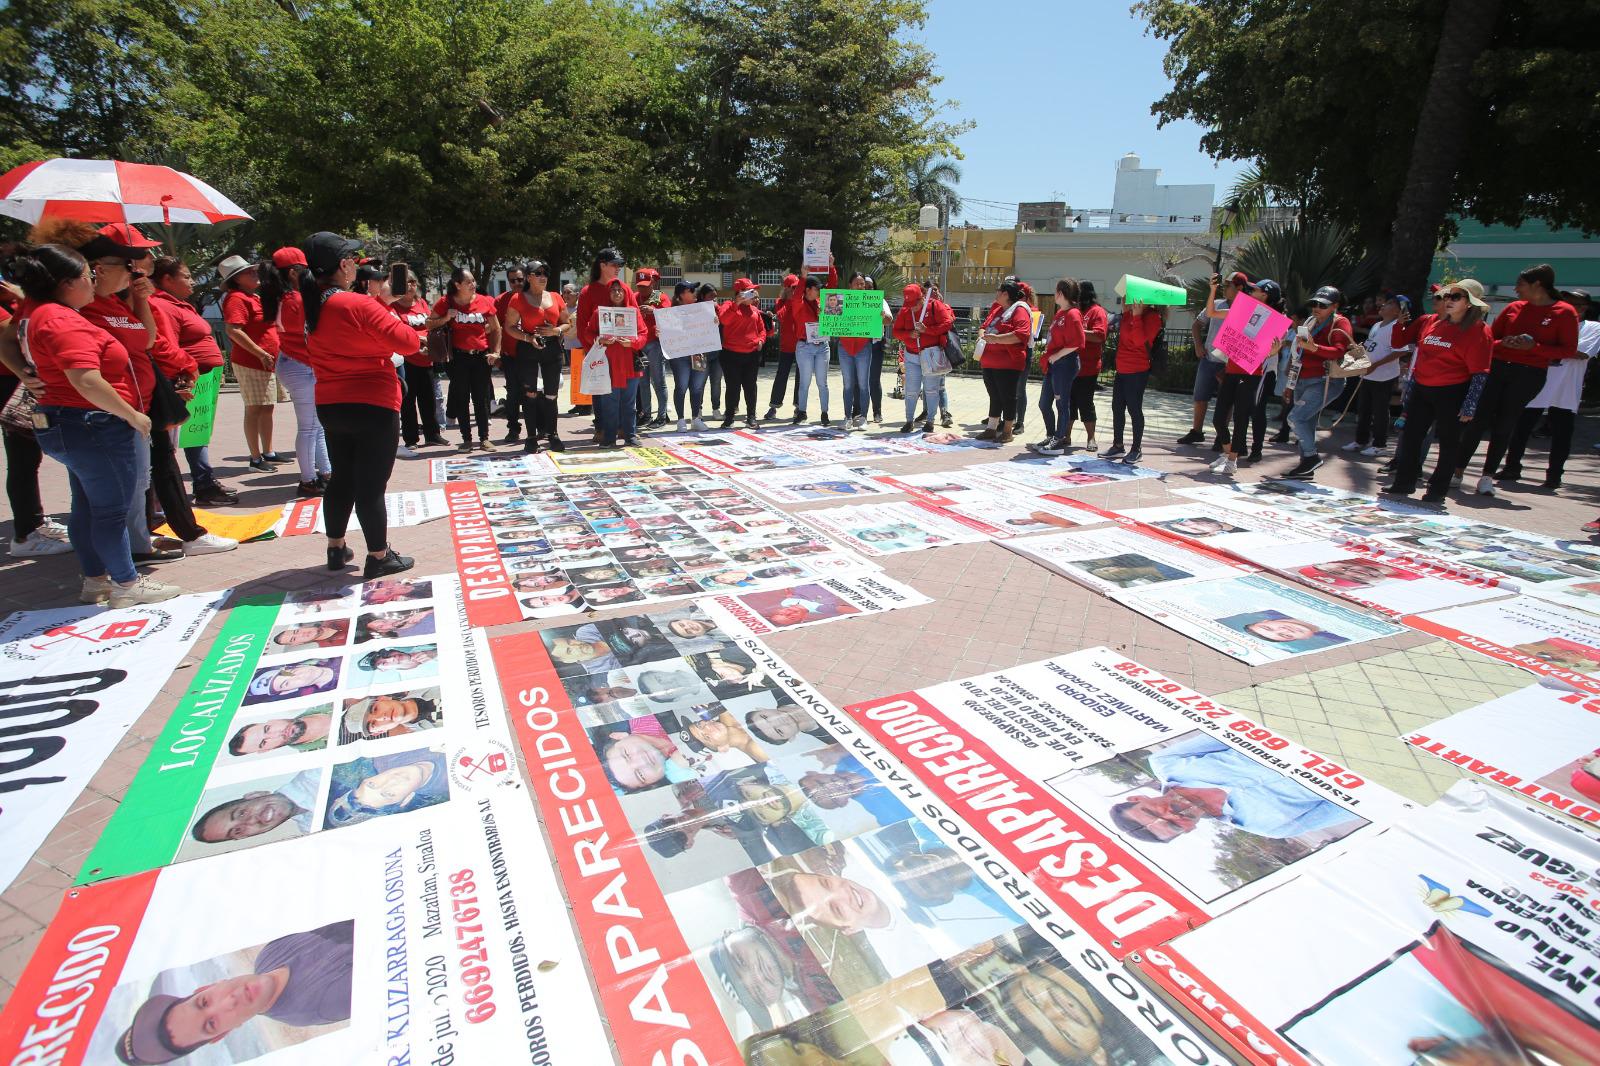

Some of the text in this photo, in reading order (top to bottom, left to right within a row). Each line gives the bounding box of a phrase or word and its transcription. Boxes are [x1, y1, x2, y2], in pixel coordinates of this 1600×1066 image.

[450, 490, 510, 600] DESAPARECIDOS
[158, 632, 256, 774] LOCALIZADOS
[470, 683, 490, 730] TESOROS
[984, 699, 1008, 713] DEL
[990, 686, 1084, 747] EN PUEBLO VIEJO
[1045, 661, 1173, 732] MARTINEZ CORONEL
[1057, 684, 1116, 717] ESIDORO
[1006, 710, 1049, 741] AGOSTO
[1045, 737, 1065, 752] DE
[1087, 730, 1116, 749] SAN
[1114, 661, 1365, 789] CEL. 669 247 67 38
[858, 736, 923, 802] HASTA
[1063, 748, 1084, 763] 16
[863, 699, 1180, 940] DESAPARECIDO
[384, 846, 404, 903] OSUNA
[417, 828, 432, 878] Sinaloa
[921, 803, 1075, 942] PERDIDOS
[419, 873, 443, 939] Mazatlan,
[499, 889, 519, 931] HASTA
[1500, 885, 1591, 937] MI HIJO
[1528, 871, 1589, 899] 2023
[385, 902, 409, 1022] LIZARRAGA
[447, 867, 498, 1025] 6692476738
[1494, 919, 1574, 966] HIJO
[425, 955, 447, 996] 2020
[1526, 955, 1587, 994] ME
[1080, 949, 1208, 1066] OROS
